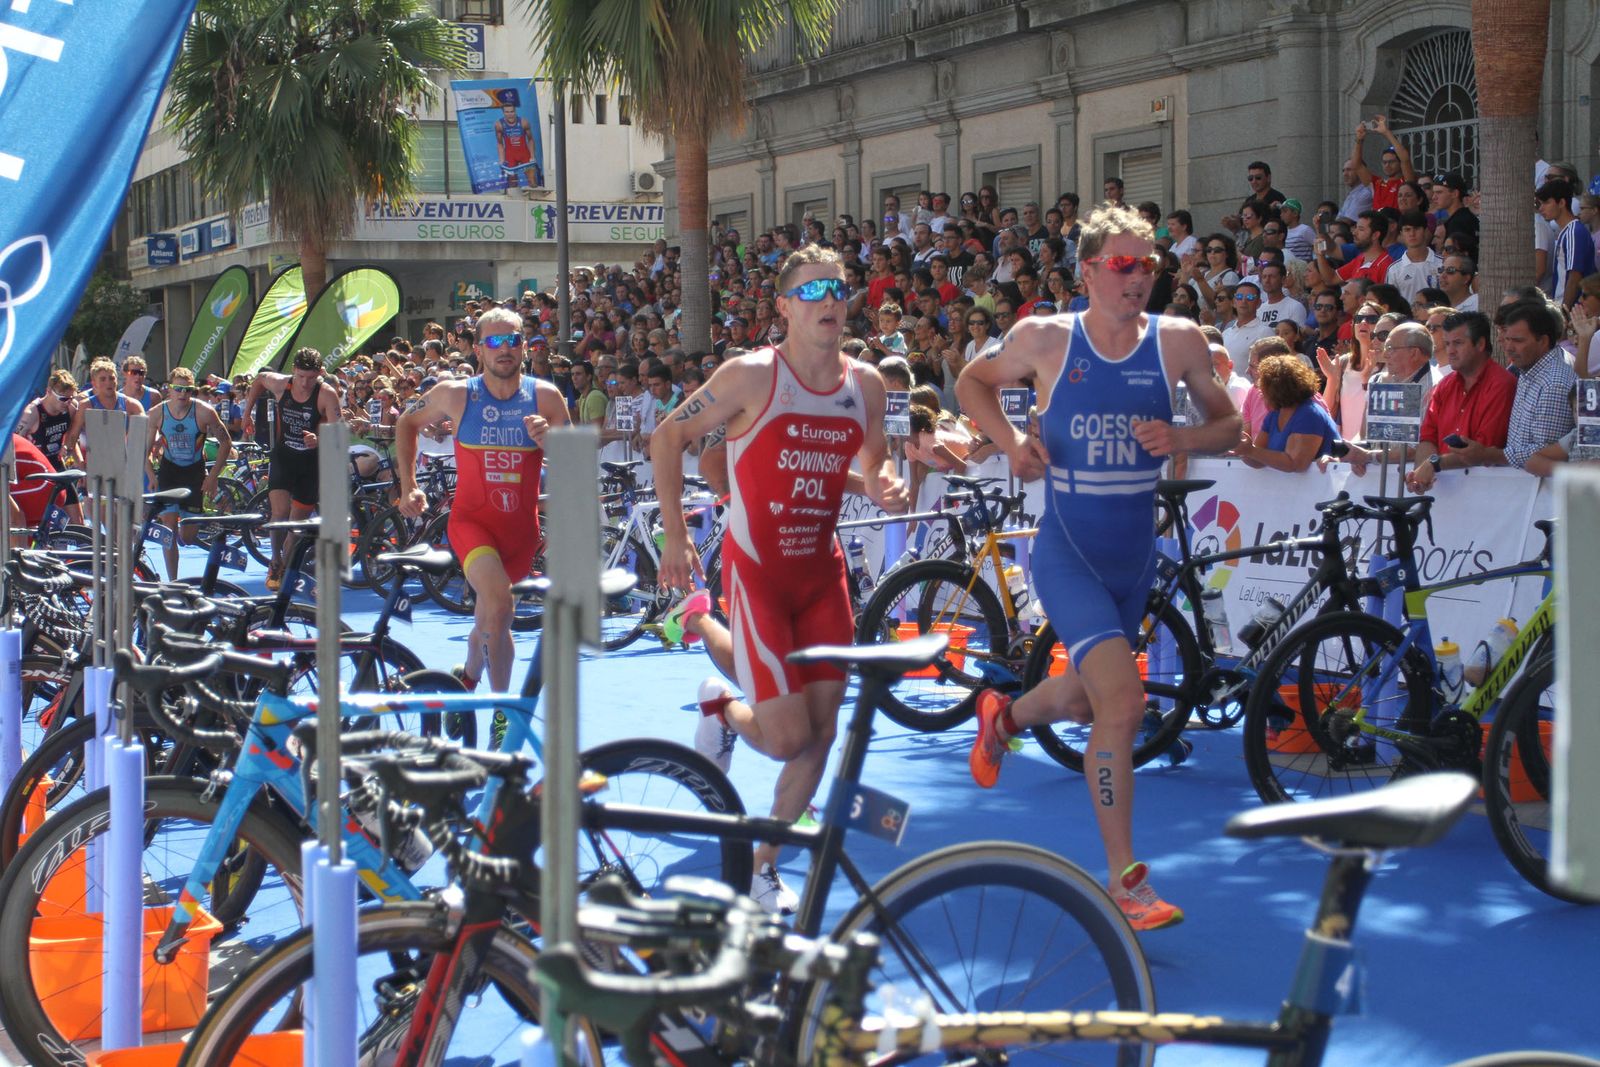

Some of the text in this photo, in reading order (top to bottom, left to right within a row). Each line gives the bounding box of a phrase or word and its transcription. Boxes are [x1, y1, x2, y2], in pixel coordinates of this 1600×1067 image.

[365, 202, 505, 219] PREVENTIVA
[417, 224, 506, 239] SEGUROS
[151, 249, 175, 258] Allianz
[457, 280, 483, 299] 24h
[1371, 391, 1386, 410] 11
[1586, 388, 1597, 411] 9
[501, 408, 522, 416] LaLiga
[480, 426, 524, 446] BENITO
[802, 424, 848, 444] Europa
[1070, 413, 1156, 441] GOESC
[484, 451, 523, 469] ESP
[1087, 441, 1137, 466] FIN
[791, 477, 826, 501] POL
[147, 526, 161, 539] 16
[779, 525, 821, 535] GARMIN
[219, 550, 233, 563] 14
[1472, 609, 1551, 717] SPECIALIZED
[1099, 767, 1114, 807] 23
